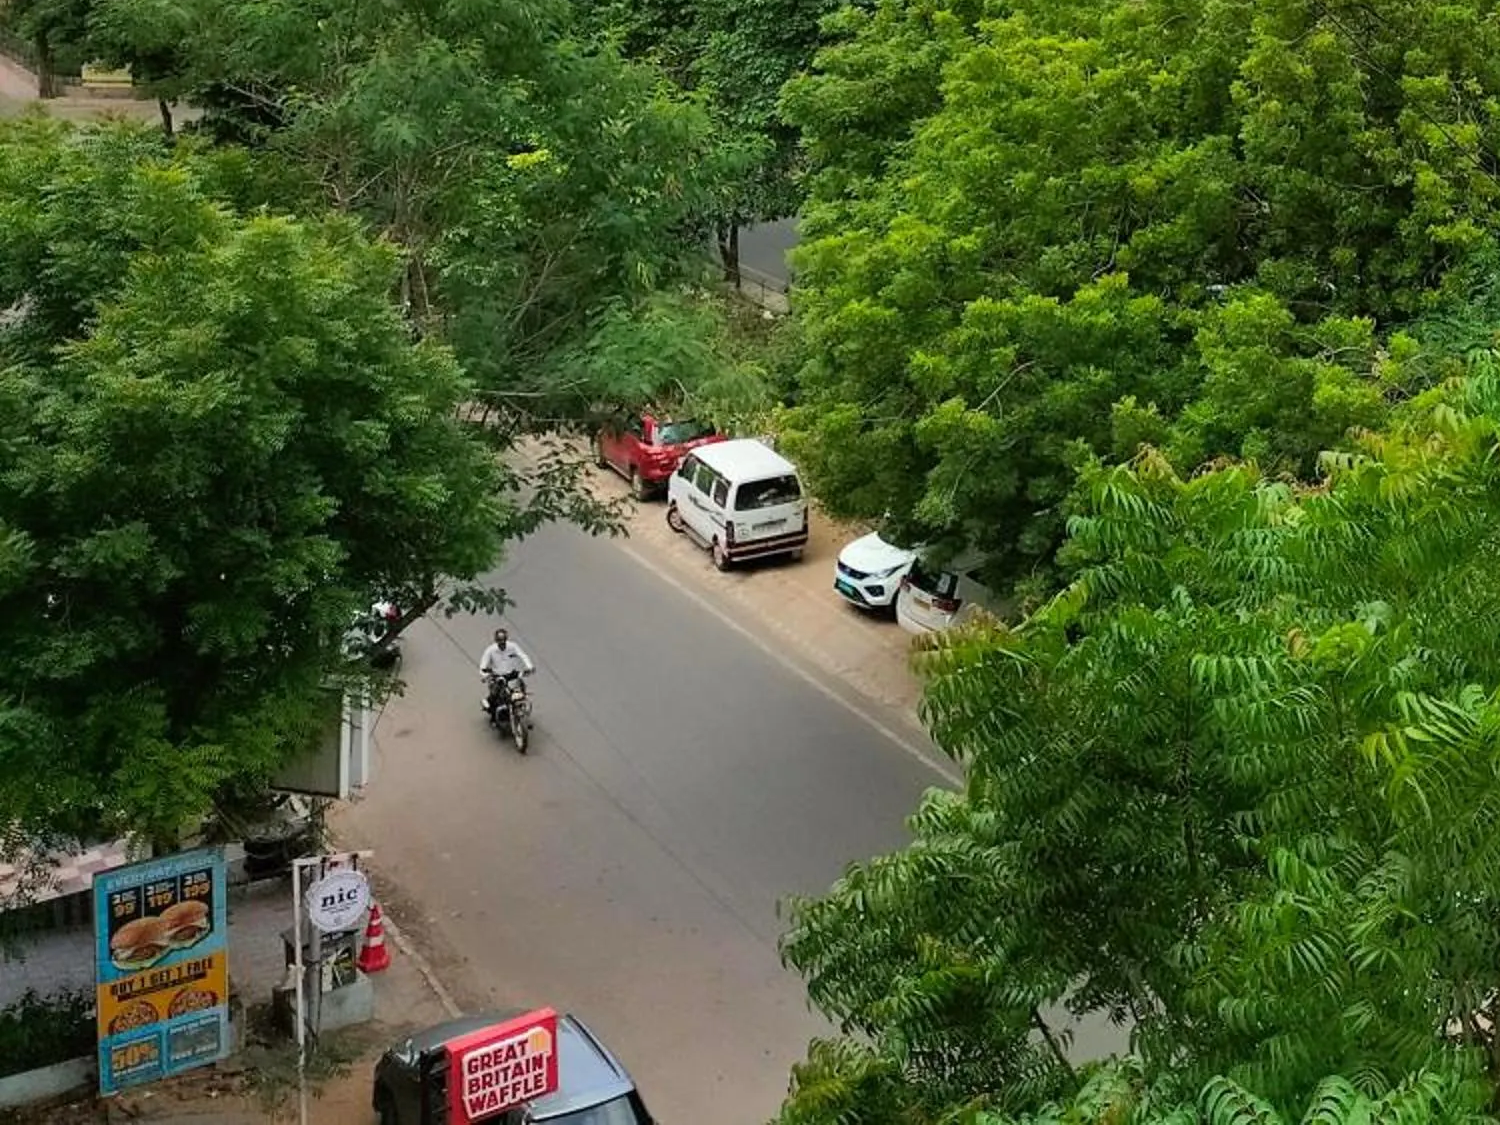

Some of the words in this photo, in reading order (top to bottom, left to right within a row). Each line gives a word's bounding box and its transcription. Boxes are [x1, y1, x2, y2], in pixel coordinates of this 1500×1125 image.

[321, 887, 358, 907] nic
[110, 980, 134, 996] BUY
[187, 957, 212, 973] FREE
[468, 1039, 528, 1075] GREAT
[468, 1053, 543, 1095] BRITAIN
[468, 1073, 544, 1112] WAFFLE
